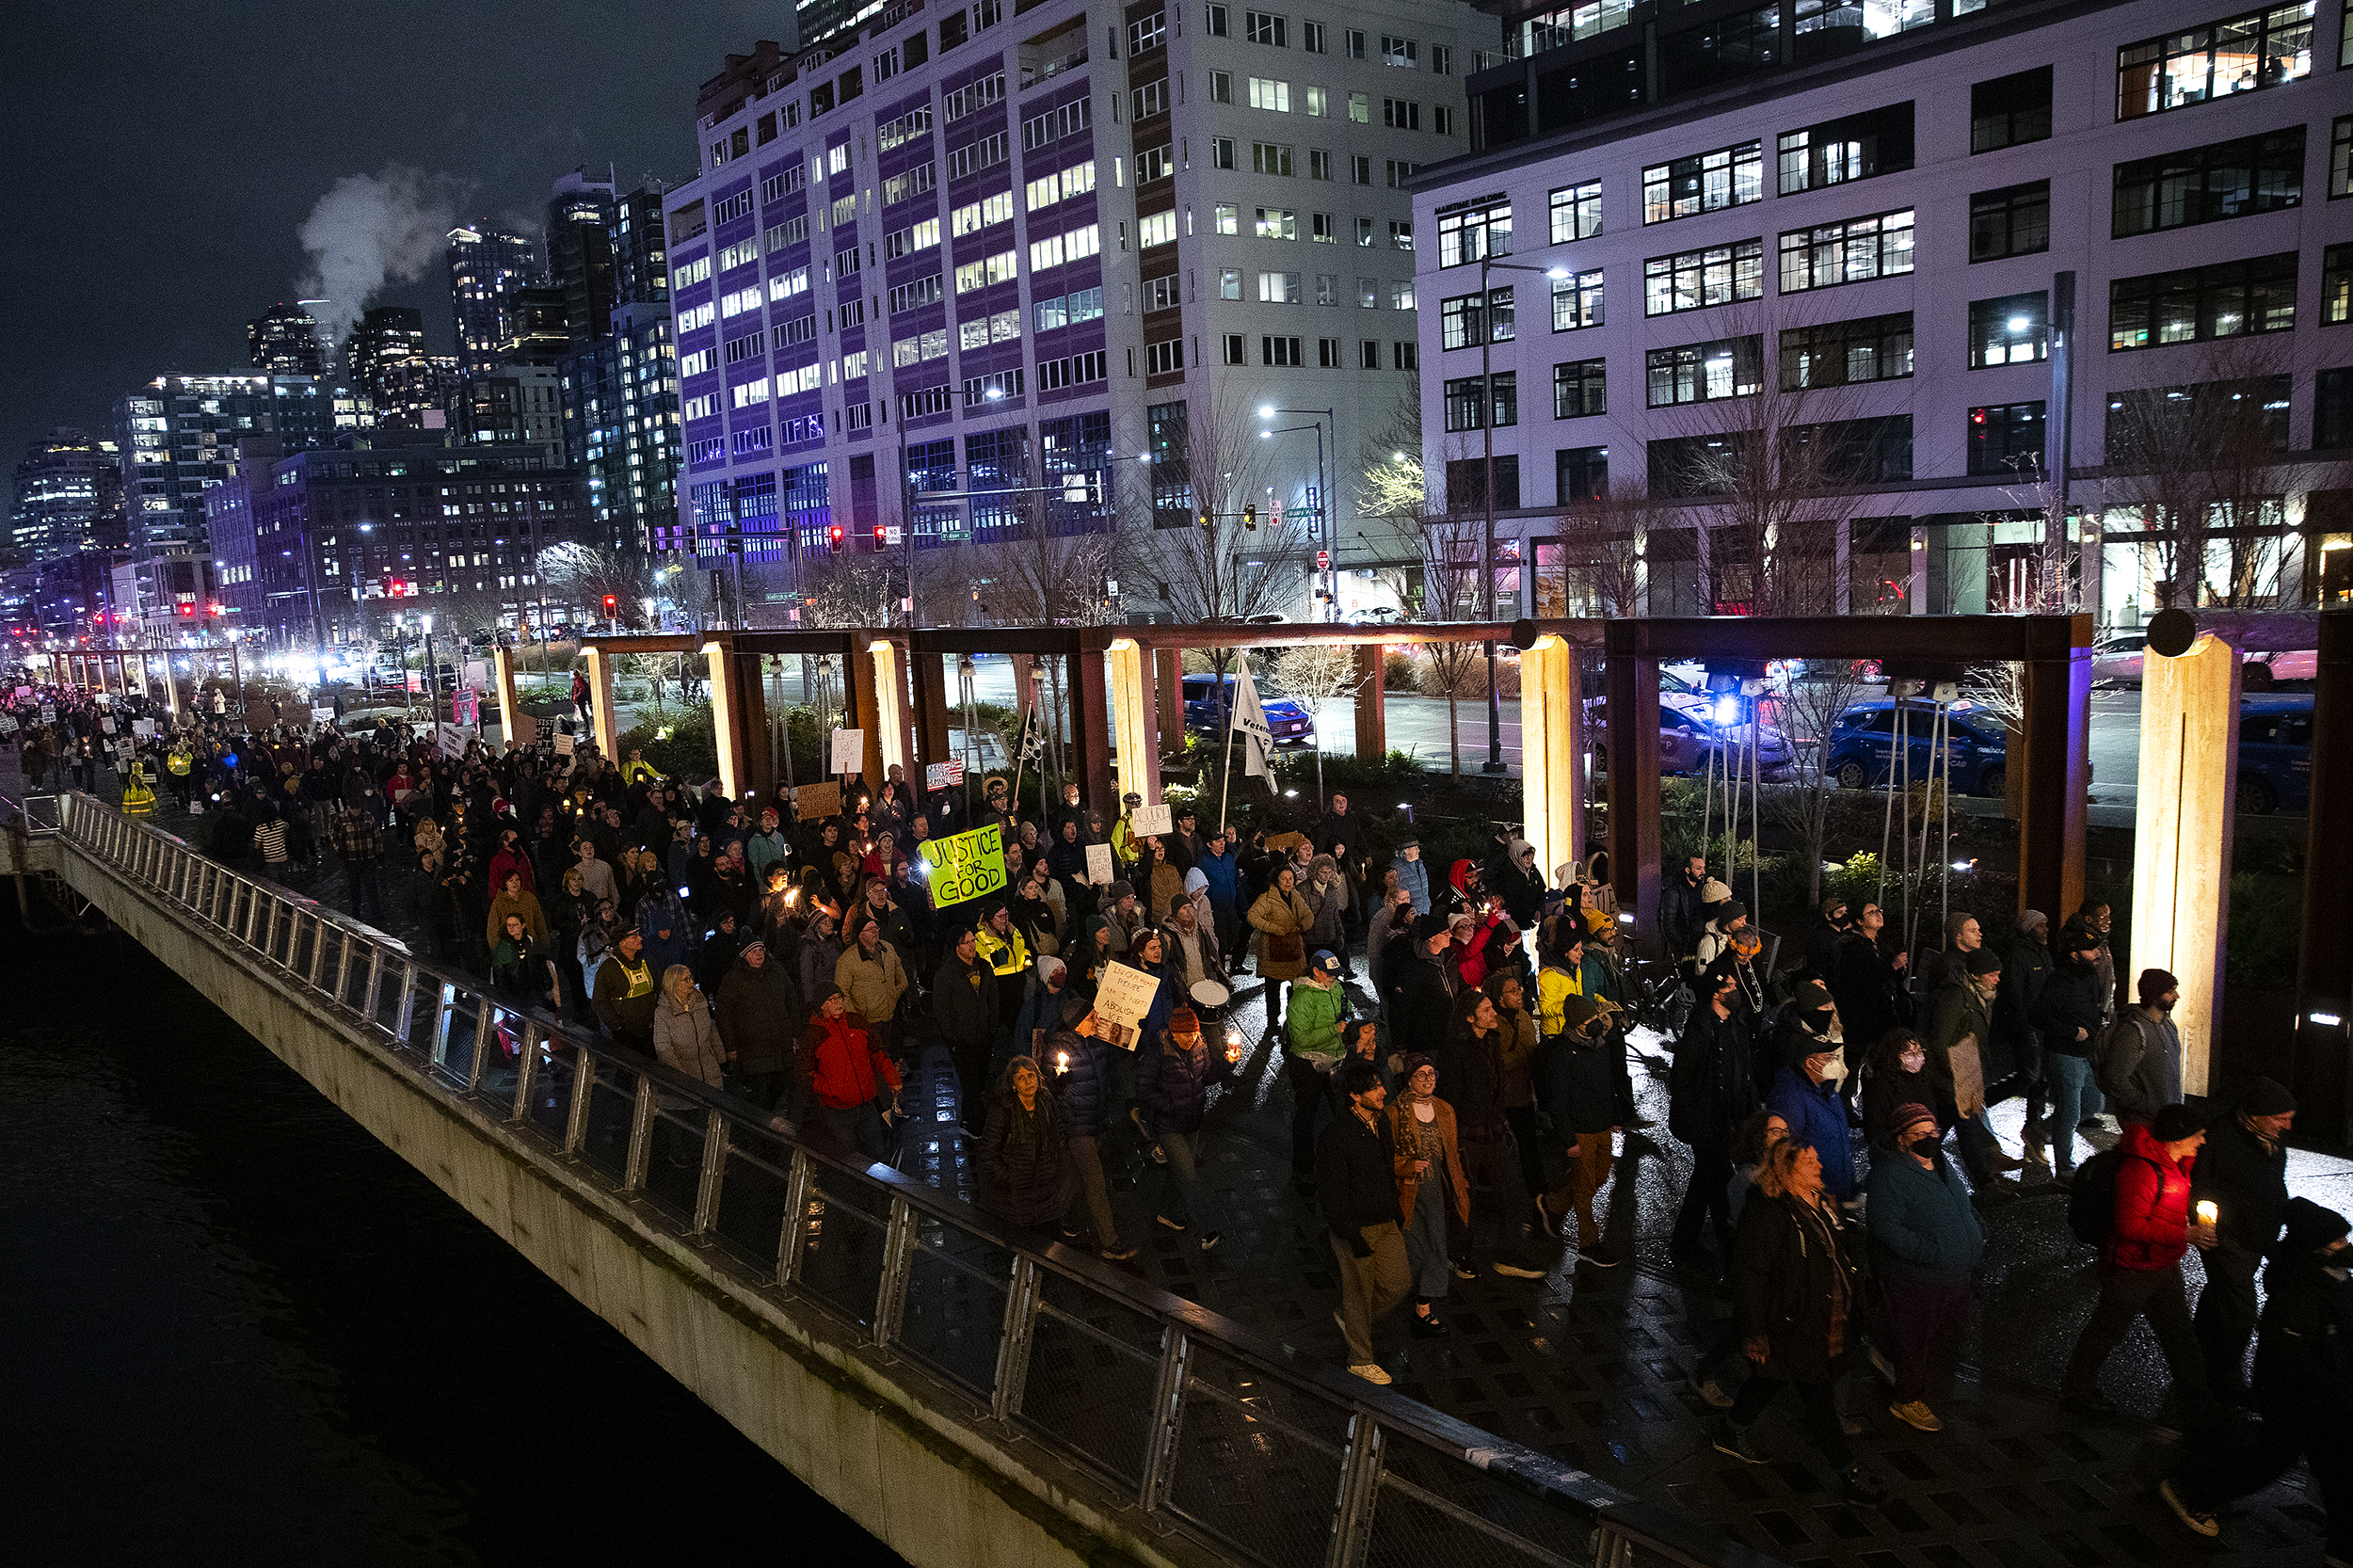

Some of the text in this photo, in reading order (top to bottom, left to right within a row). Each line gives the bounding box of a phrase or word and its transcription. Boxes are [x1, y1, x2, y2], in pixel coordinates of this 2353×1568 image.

[1434, 190, 1507, 215] MARITIME BUILDING
[1142, 823, 1160, 835] ICE
[930, 827, 1000, 868] JUSTICE
[957, 860, 987, 879] FOR
[940, 869, 1000, 901] GOOD
[1112, 965, 1125, 975] IN
[1126, 970, 1139, 981] OUR
[1121, 991, 1127, 1000] I
[1102, 1000, 1134, 1016] ABOLISH
